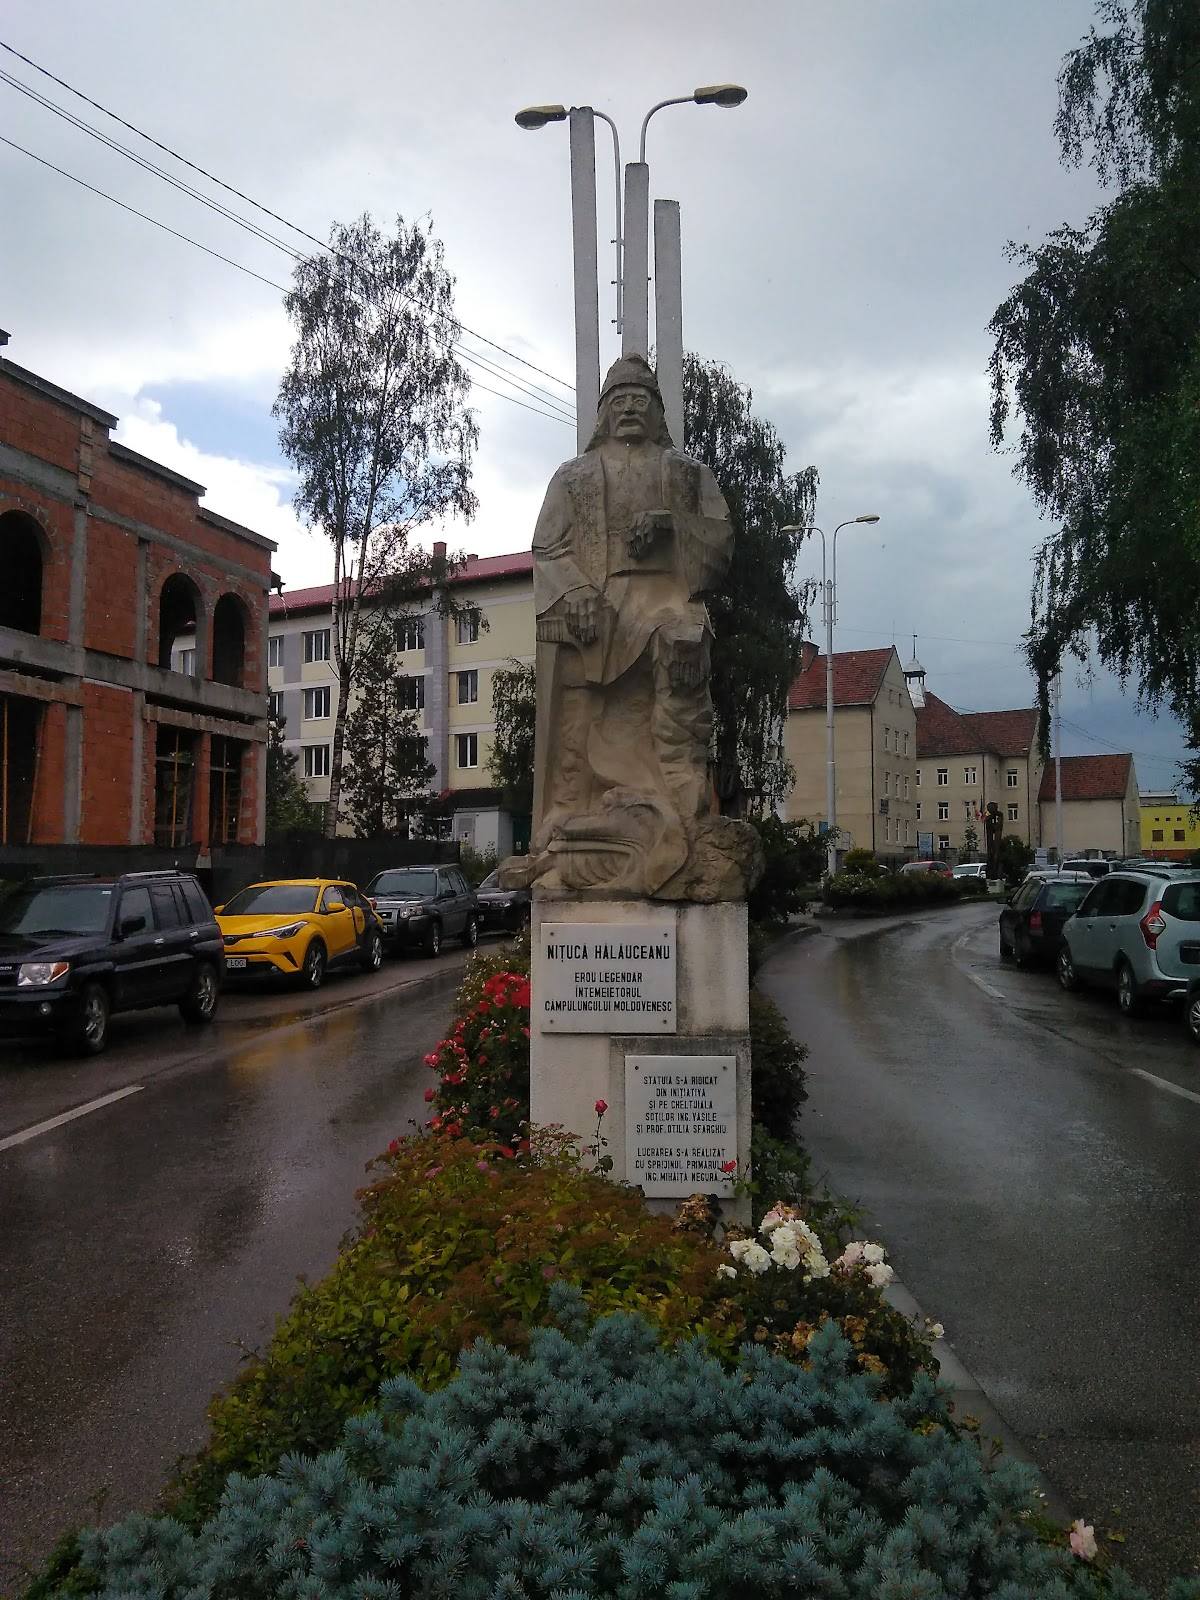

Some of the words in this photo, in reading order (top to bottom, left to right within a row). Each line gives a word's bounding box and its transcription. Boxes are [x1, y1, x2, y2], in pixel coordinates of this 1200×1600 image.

[574, 972, 597, 983] EROU
[599, 972, 643, 983] LEGENDAR
[575, 984, 642, 998] ÎNTEMEIETORUL
[545, 998, 611, 1012] CÂMPULUNGULUI
[613, 1000, 673, 1012] MOLDOVENESC
[643, 1076, 673, 1085] STATUIA
[675, 1076, 689, 1085] S-A
[691, 1076, 718, 1085] RIDICAT
[656, 1088, 667, 1097] DIN
[670, 1088, 707, 1098] INIȚIATIVA
[658, 1100, 668, 1109] PE
[671, 1100, 713, 1109] CHELTUIALA
[645, 1112, 675, 1122] SOȚILOR
[692, 1112, 717, 1121] VASILE
[667, 1124, 690, 1134] OTILIA
[637, 1148, 673, 1157] LUCRAREA
[676, 1148, 689, 1157] S-A
[692, 1148, 726, 1158] REALIZAT
[635, 1160, 645, 1169] CU
[647, 1160, 684, 1169] SPRIJINUL
